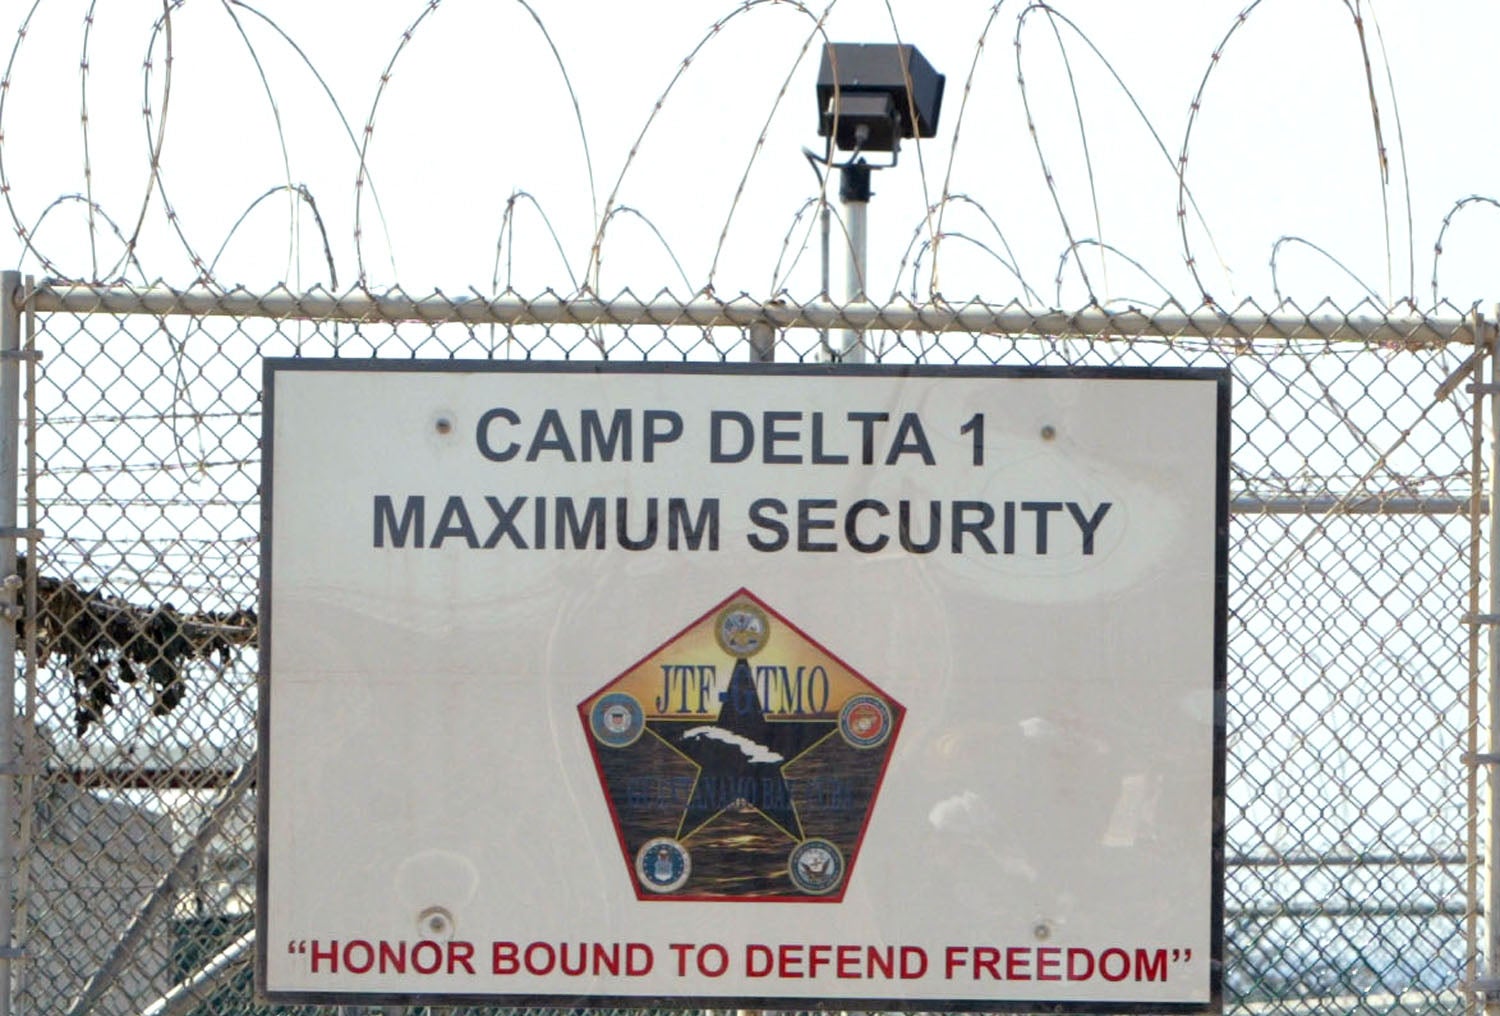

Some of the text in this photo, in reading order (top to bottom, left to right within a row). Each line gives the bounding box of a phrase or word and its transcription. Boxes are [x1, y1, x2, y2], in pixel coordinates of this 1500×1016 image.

[476, 408, 986, 467] CAMP DELTA 1
[373, 495, 1113, 556] MAXIMUM SECURITY
[655, 664, 829, 717] JTF-GTMO
[286, 939, 1194, 982] “HONOR BOUND TO DEFEND FREEDOM”
